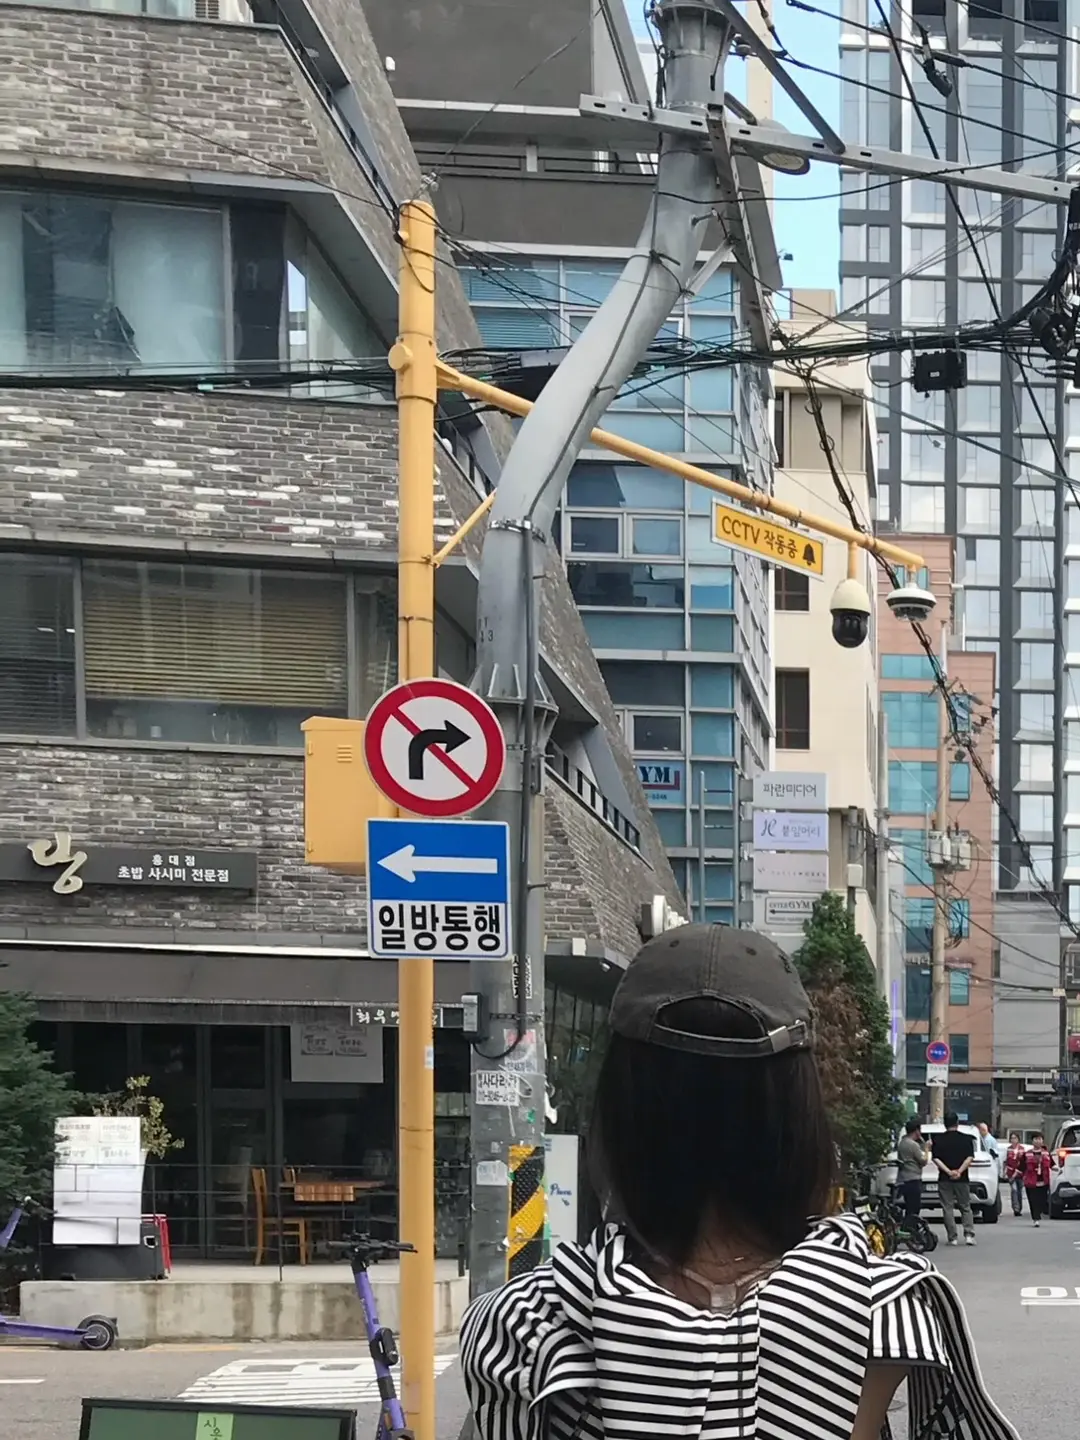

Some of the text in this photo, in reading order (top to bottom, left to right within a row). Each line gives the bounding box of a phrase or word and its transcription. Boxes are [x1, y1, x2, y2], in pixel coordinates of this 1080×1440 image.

[721, 515, 799, 559] CCTV 작동중
[637, 766, 671, 783] YM
[762, 783, 818, 798] 파란미디어
[151, 855, 196, 867] 홍대점
[117, 866, 230, 883] 초밥 사시미 전문점
[378, 903, 501, 952] 일방통행
